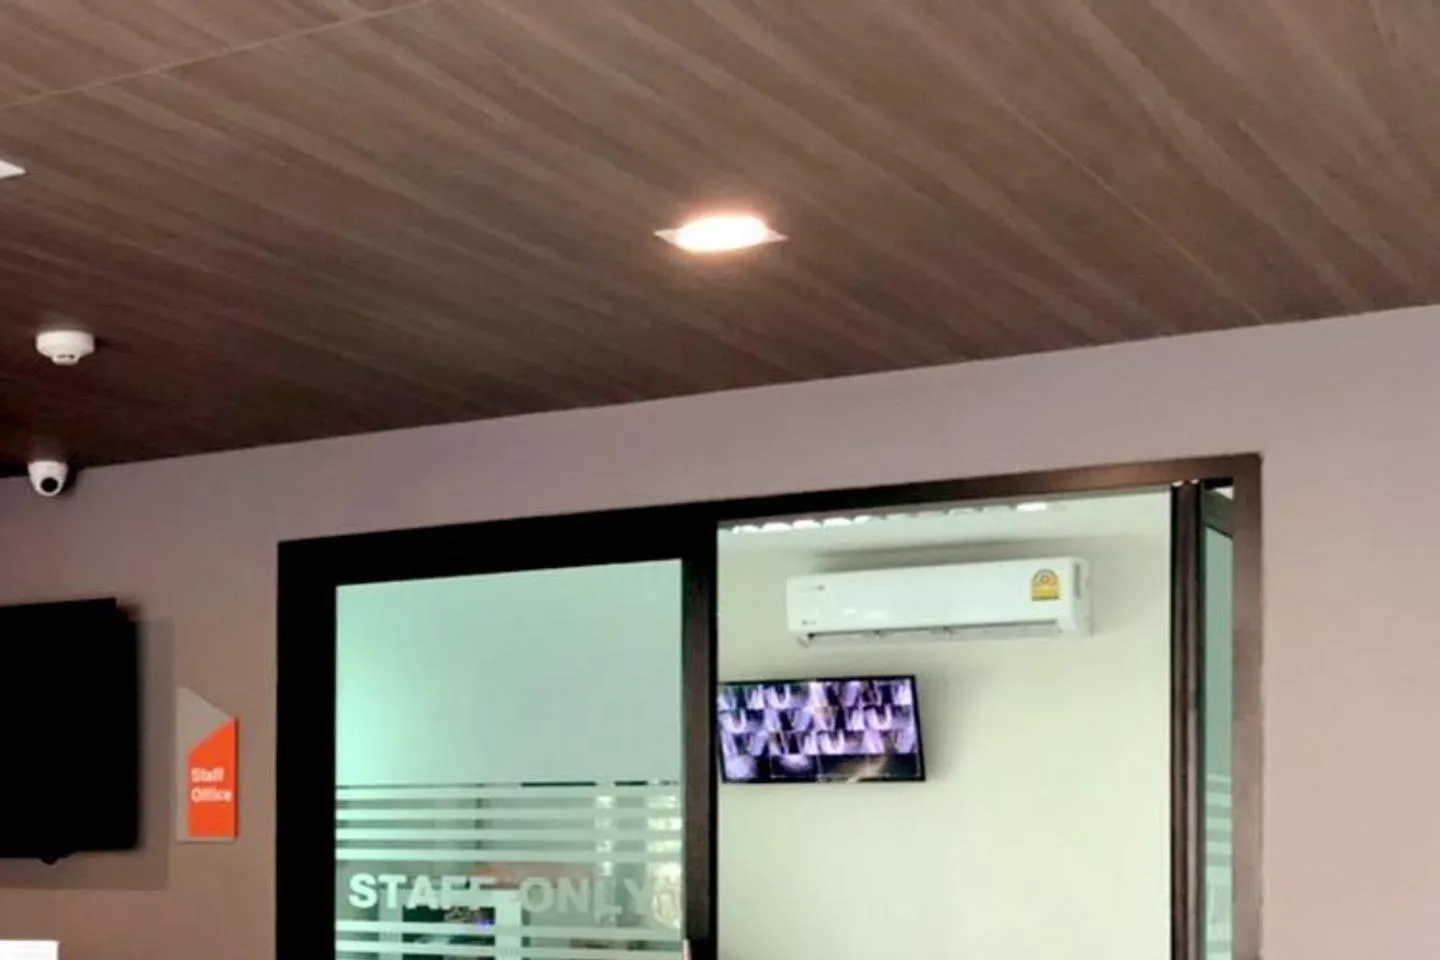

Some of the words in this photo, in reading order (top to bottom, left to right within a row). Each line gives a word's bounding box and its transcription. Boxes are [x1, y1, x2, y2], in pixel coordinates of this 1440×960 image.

[191, 767, 225, 782] Staff
[191, 787, 232, 803] Office
[348, 873, 496, 911] STAFF
[519, 876, 655, 915] ONLY
